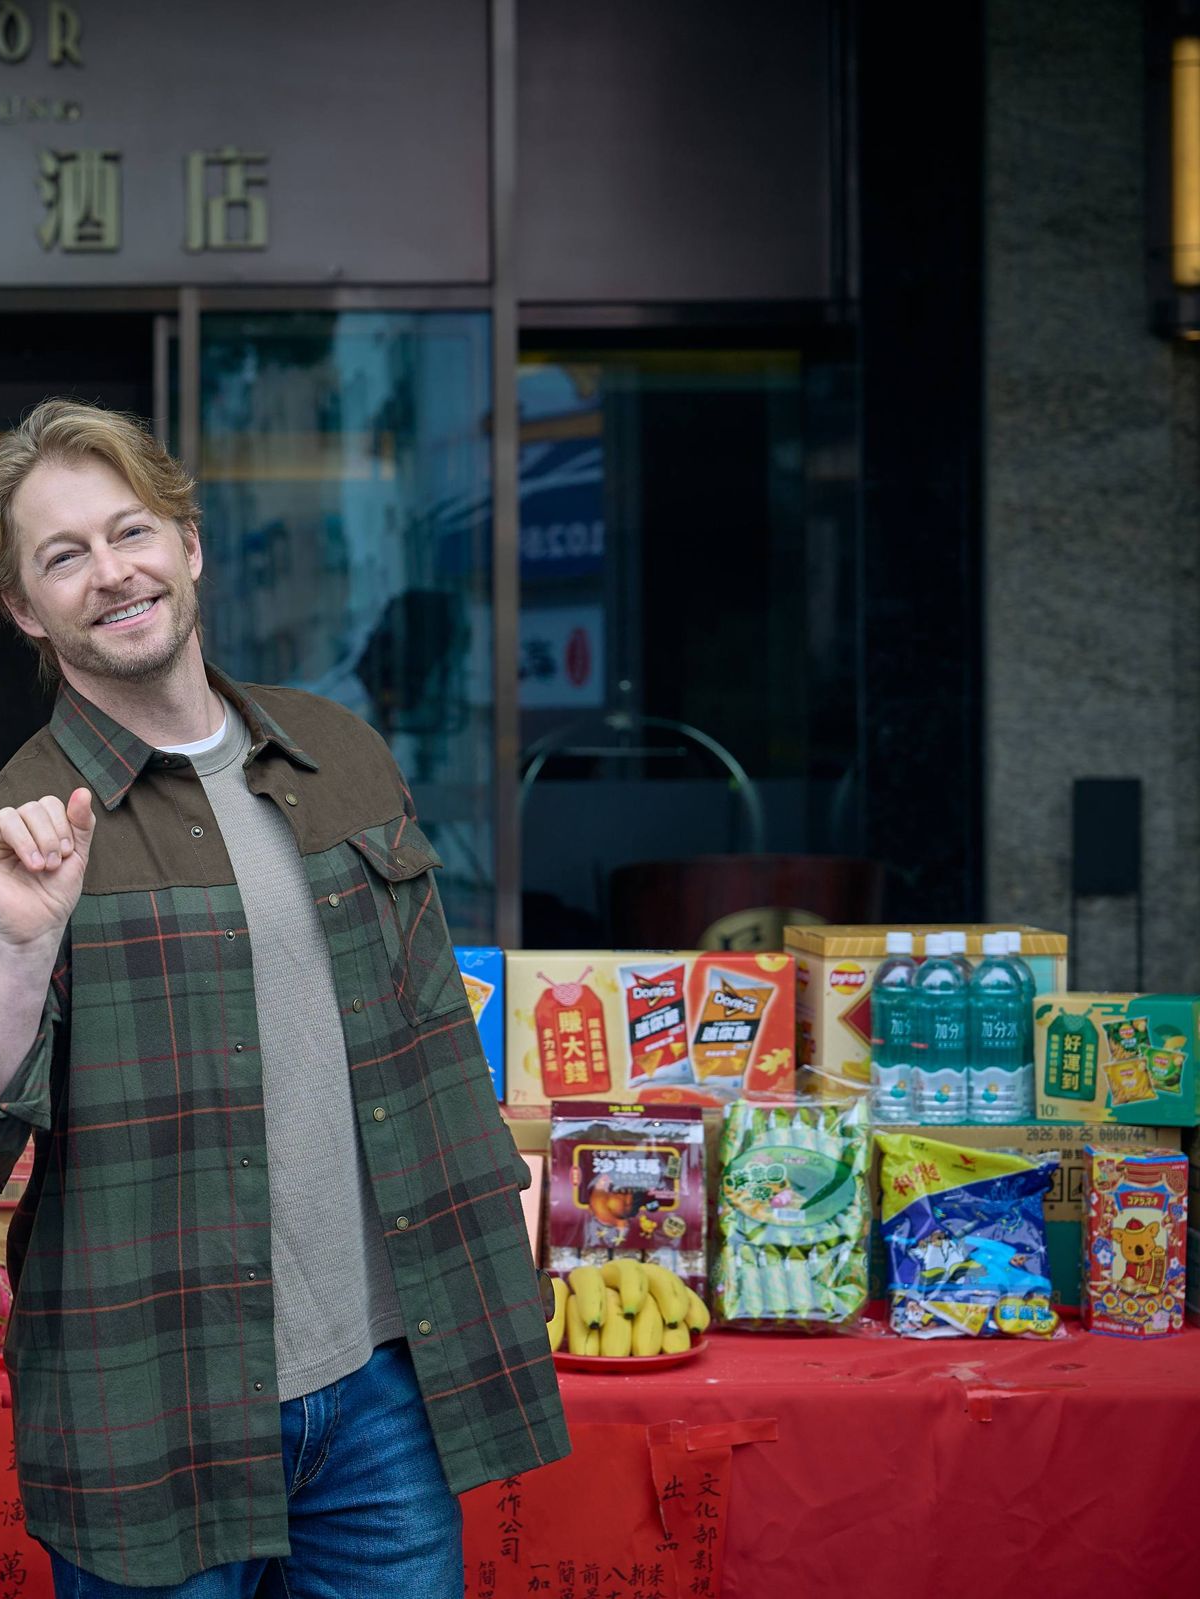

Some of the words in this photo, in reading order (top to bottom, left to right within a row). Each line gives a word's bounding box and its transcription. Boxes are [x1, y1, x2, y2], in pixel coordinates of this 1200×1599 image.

[558, 1010, 588, 1084] 賺大錢
[1061, 1034, 1082, 1091] 好運到
[592, 1158, 661, 1174] 沙琪瑪
[689, 1472, 721, 1599] 文化部影視
